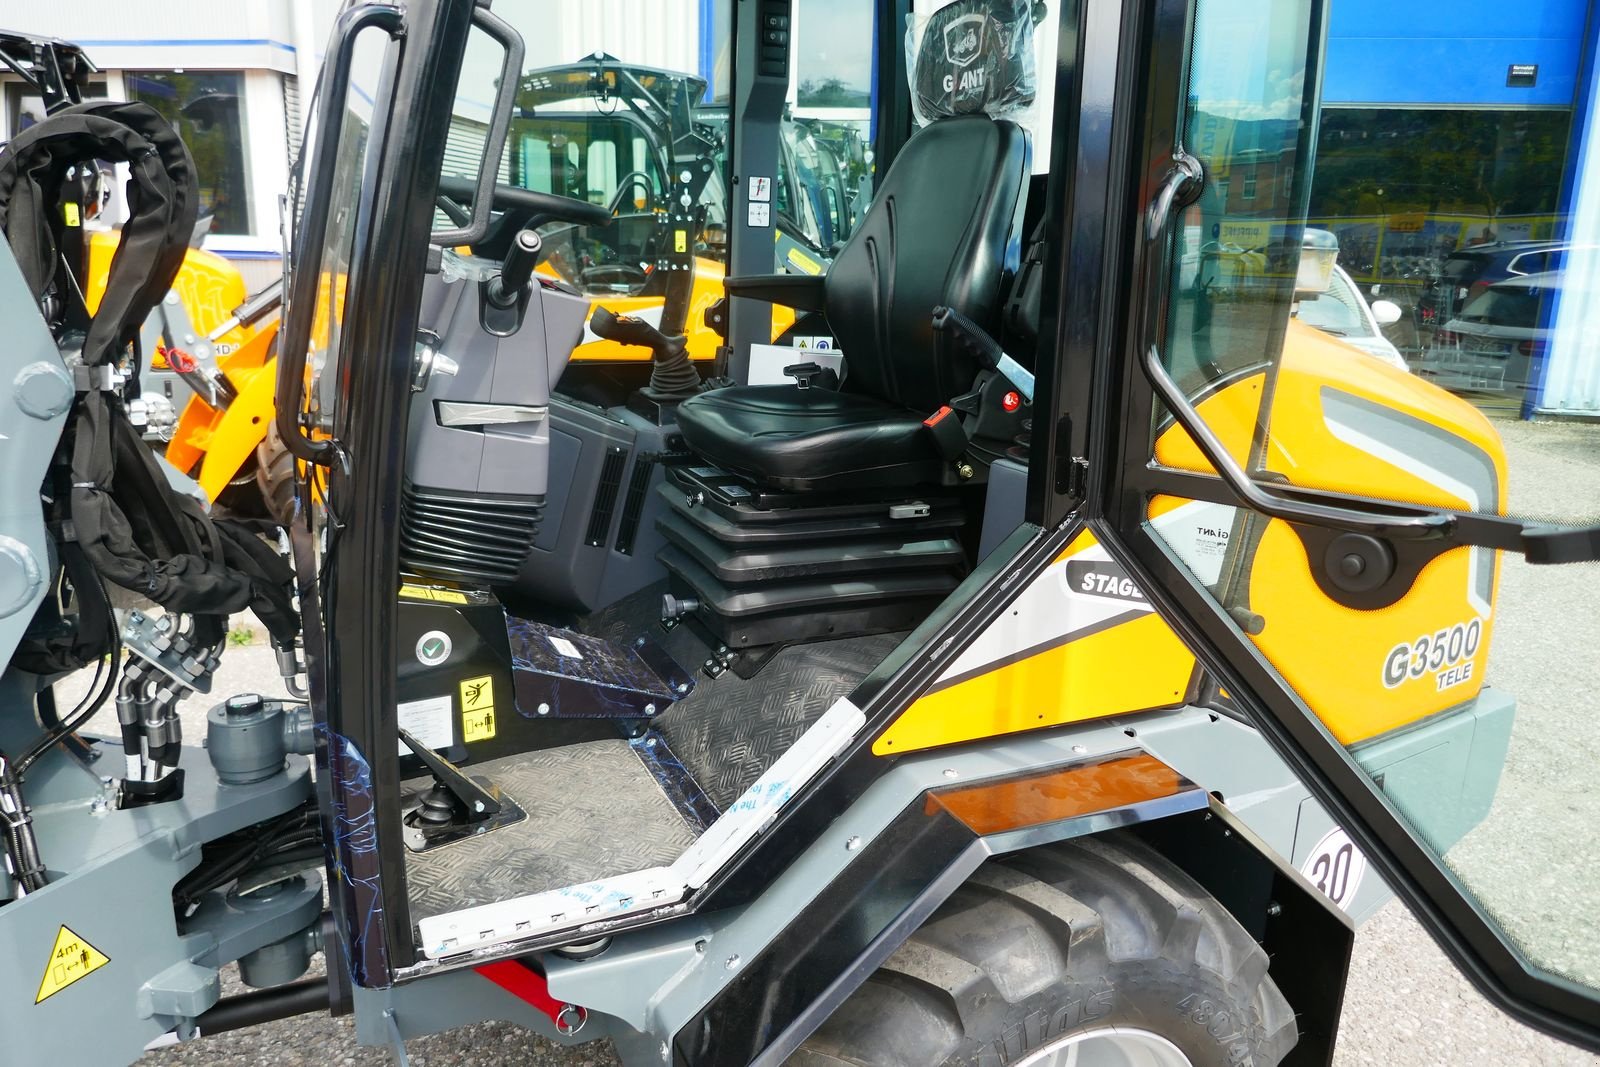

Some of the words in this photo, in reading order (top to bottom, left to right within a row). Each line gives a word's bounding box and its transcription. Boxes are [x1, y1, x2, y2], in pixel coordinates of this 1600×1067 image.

[943, 65, 984, 92] GANT
[1383, 618, 1481, 688] G3500
[1438, 662, 1473, 690] TELE
[1312, 842, 1353, 904] 30
[57, 942, 79, 959] 4m
